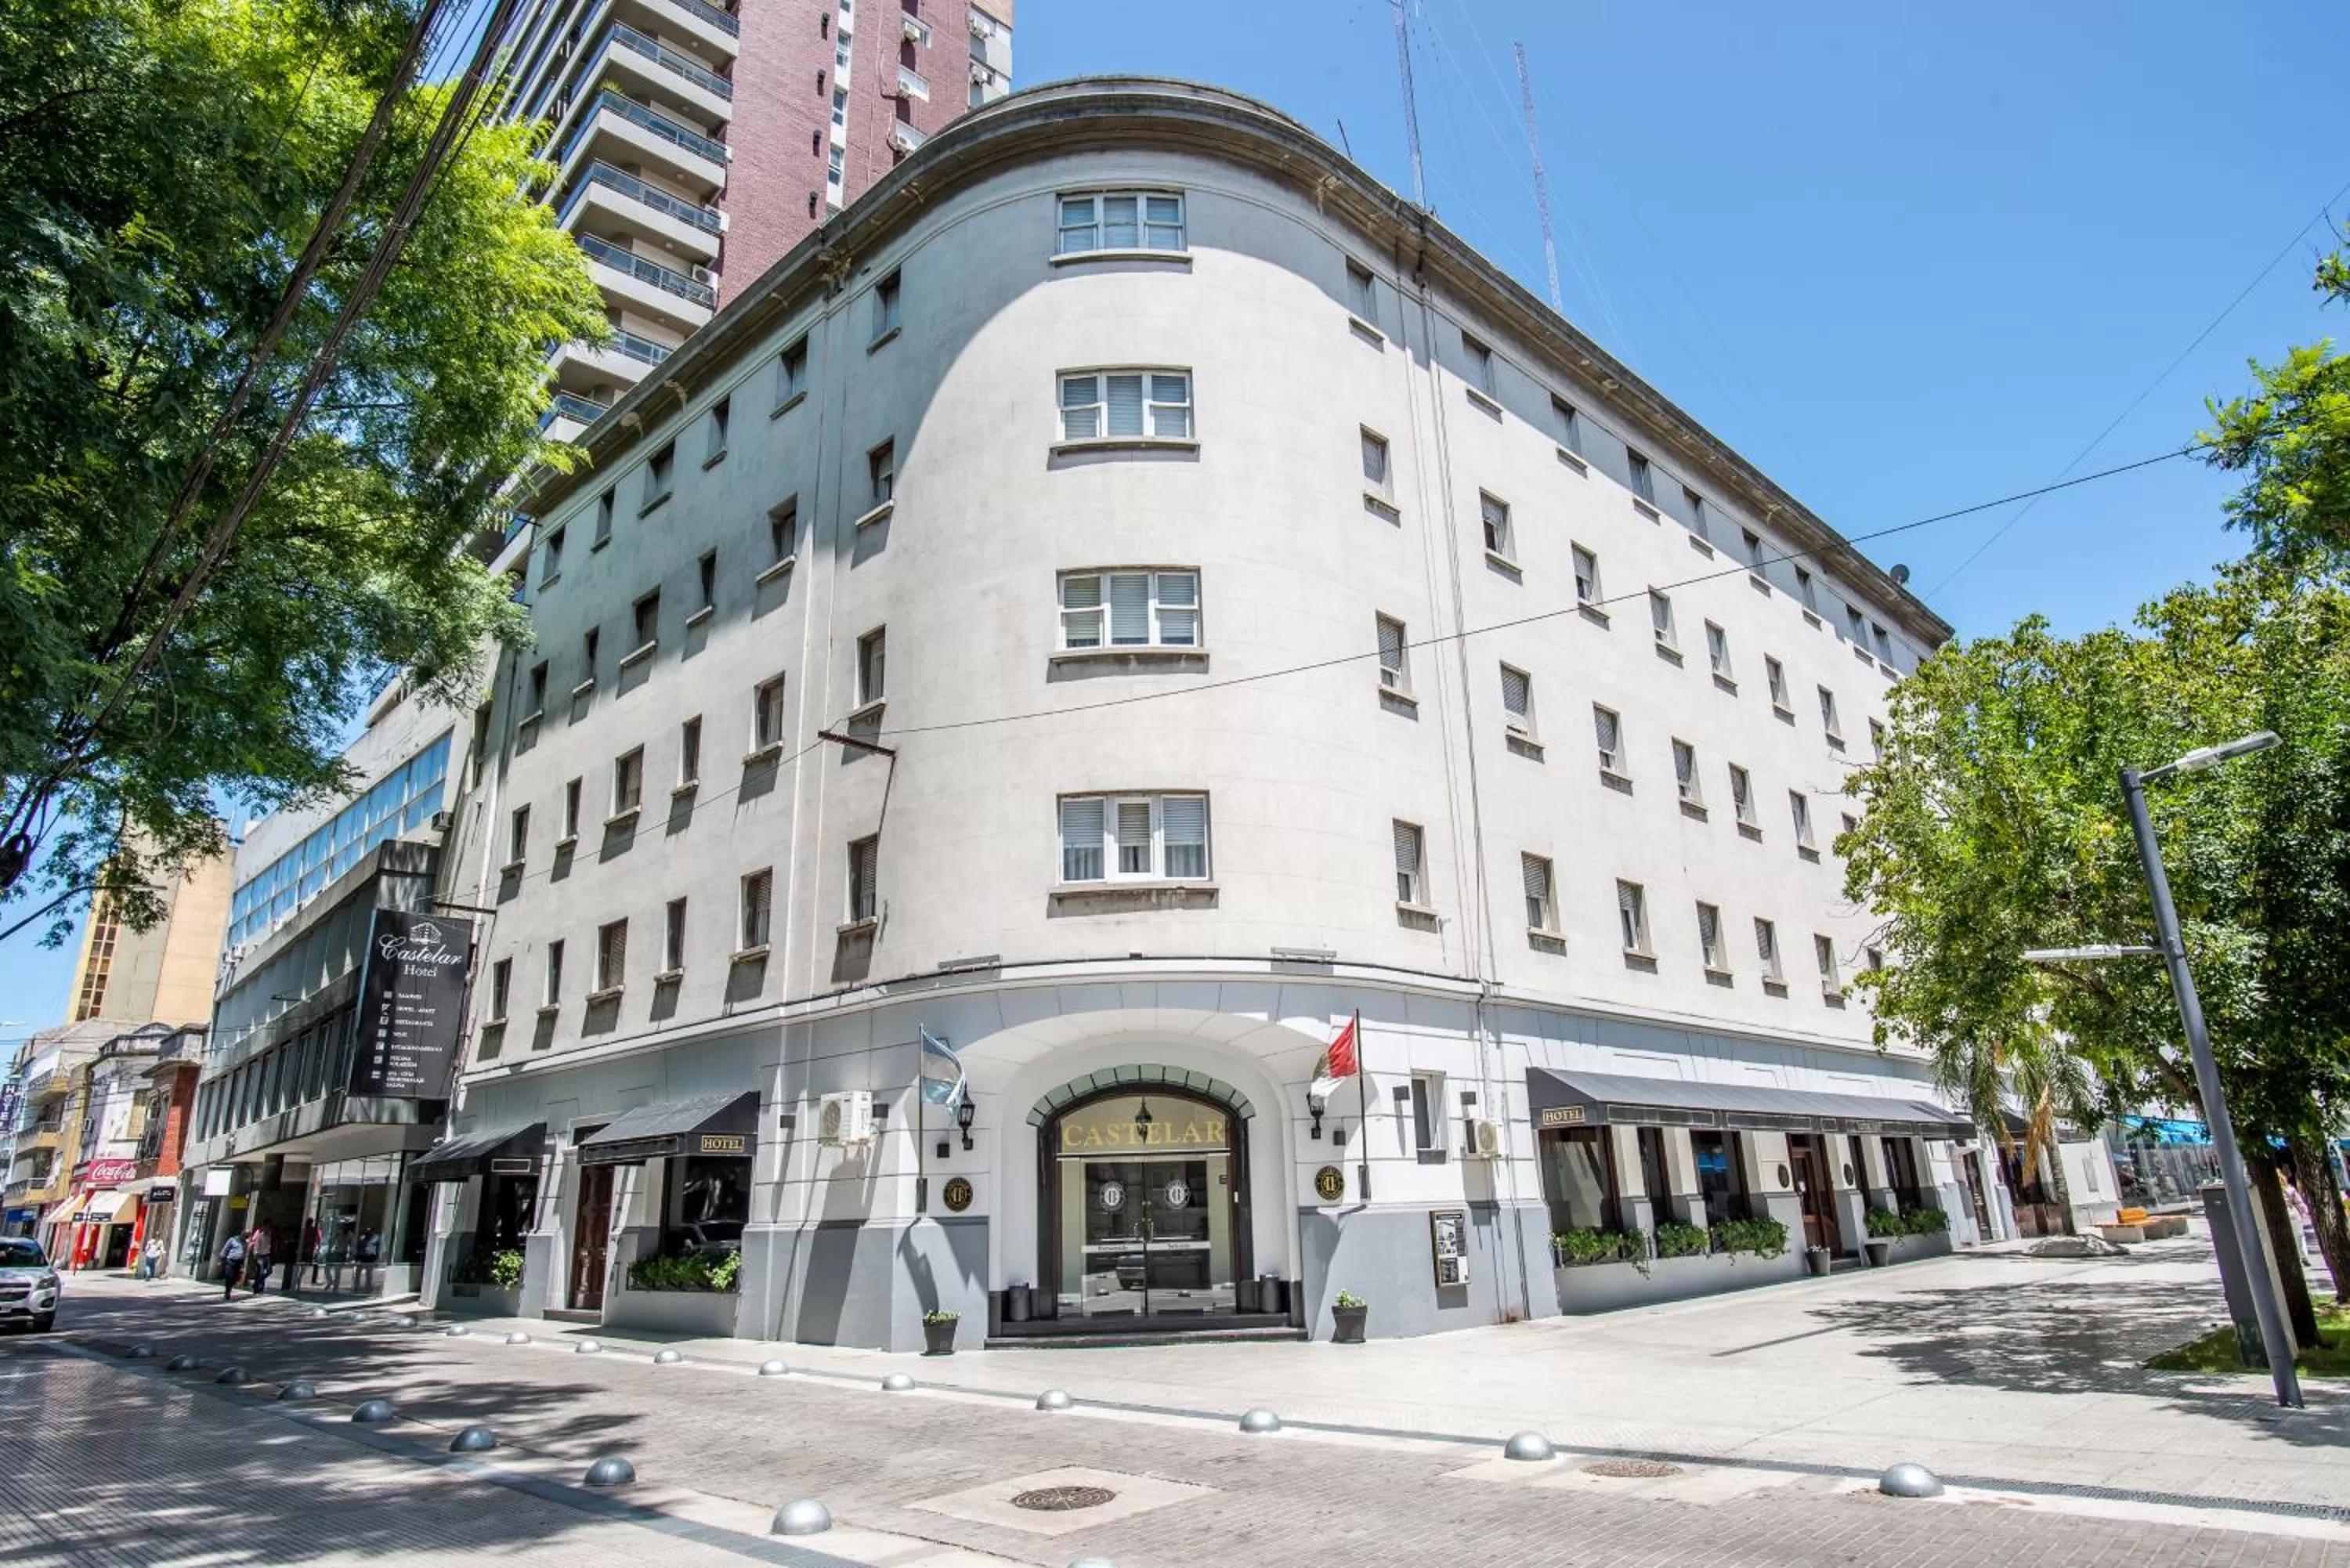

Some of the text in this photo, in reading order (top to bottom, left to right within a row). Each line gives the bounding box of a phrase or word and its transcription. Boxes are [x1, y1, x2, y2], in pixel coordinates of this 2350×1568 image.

[378, 934, 462, 965] Castelar
[403, 964, 438, 977] Hotel
[1545, 1109, 1582, 1122] HOTEL
[1063, 1121, 1225, 1146] CASTELAR
[704, 1139, 741, 1150] HOTEL
